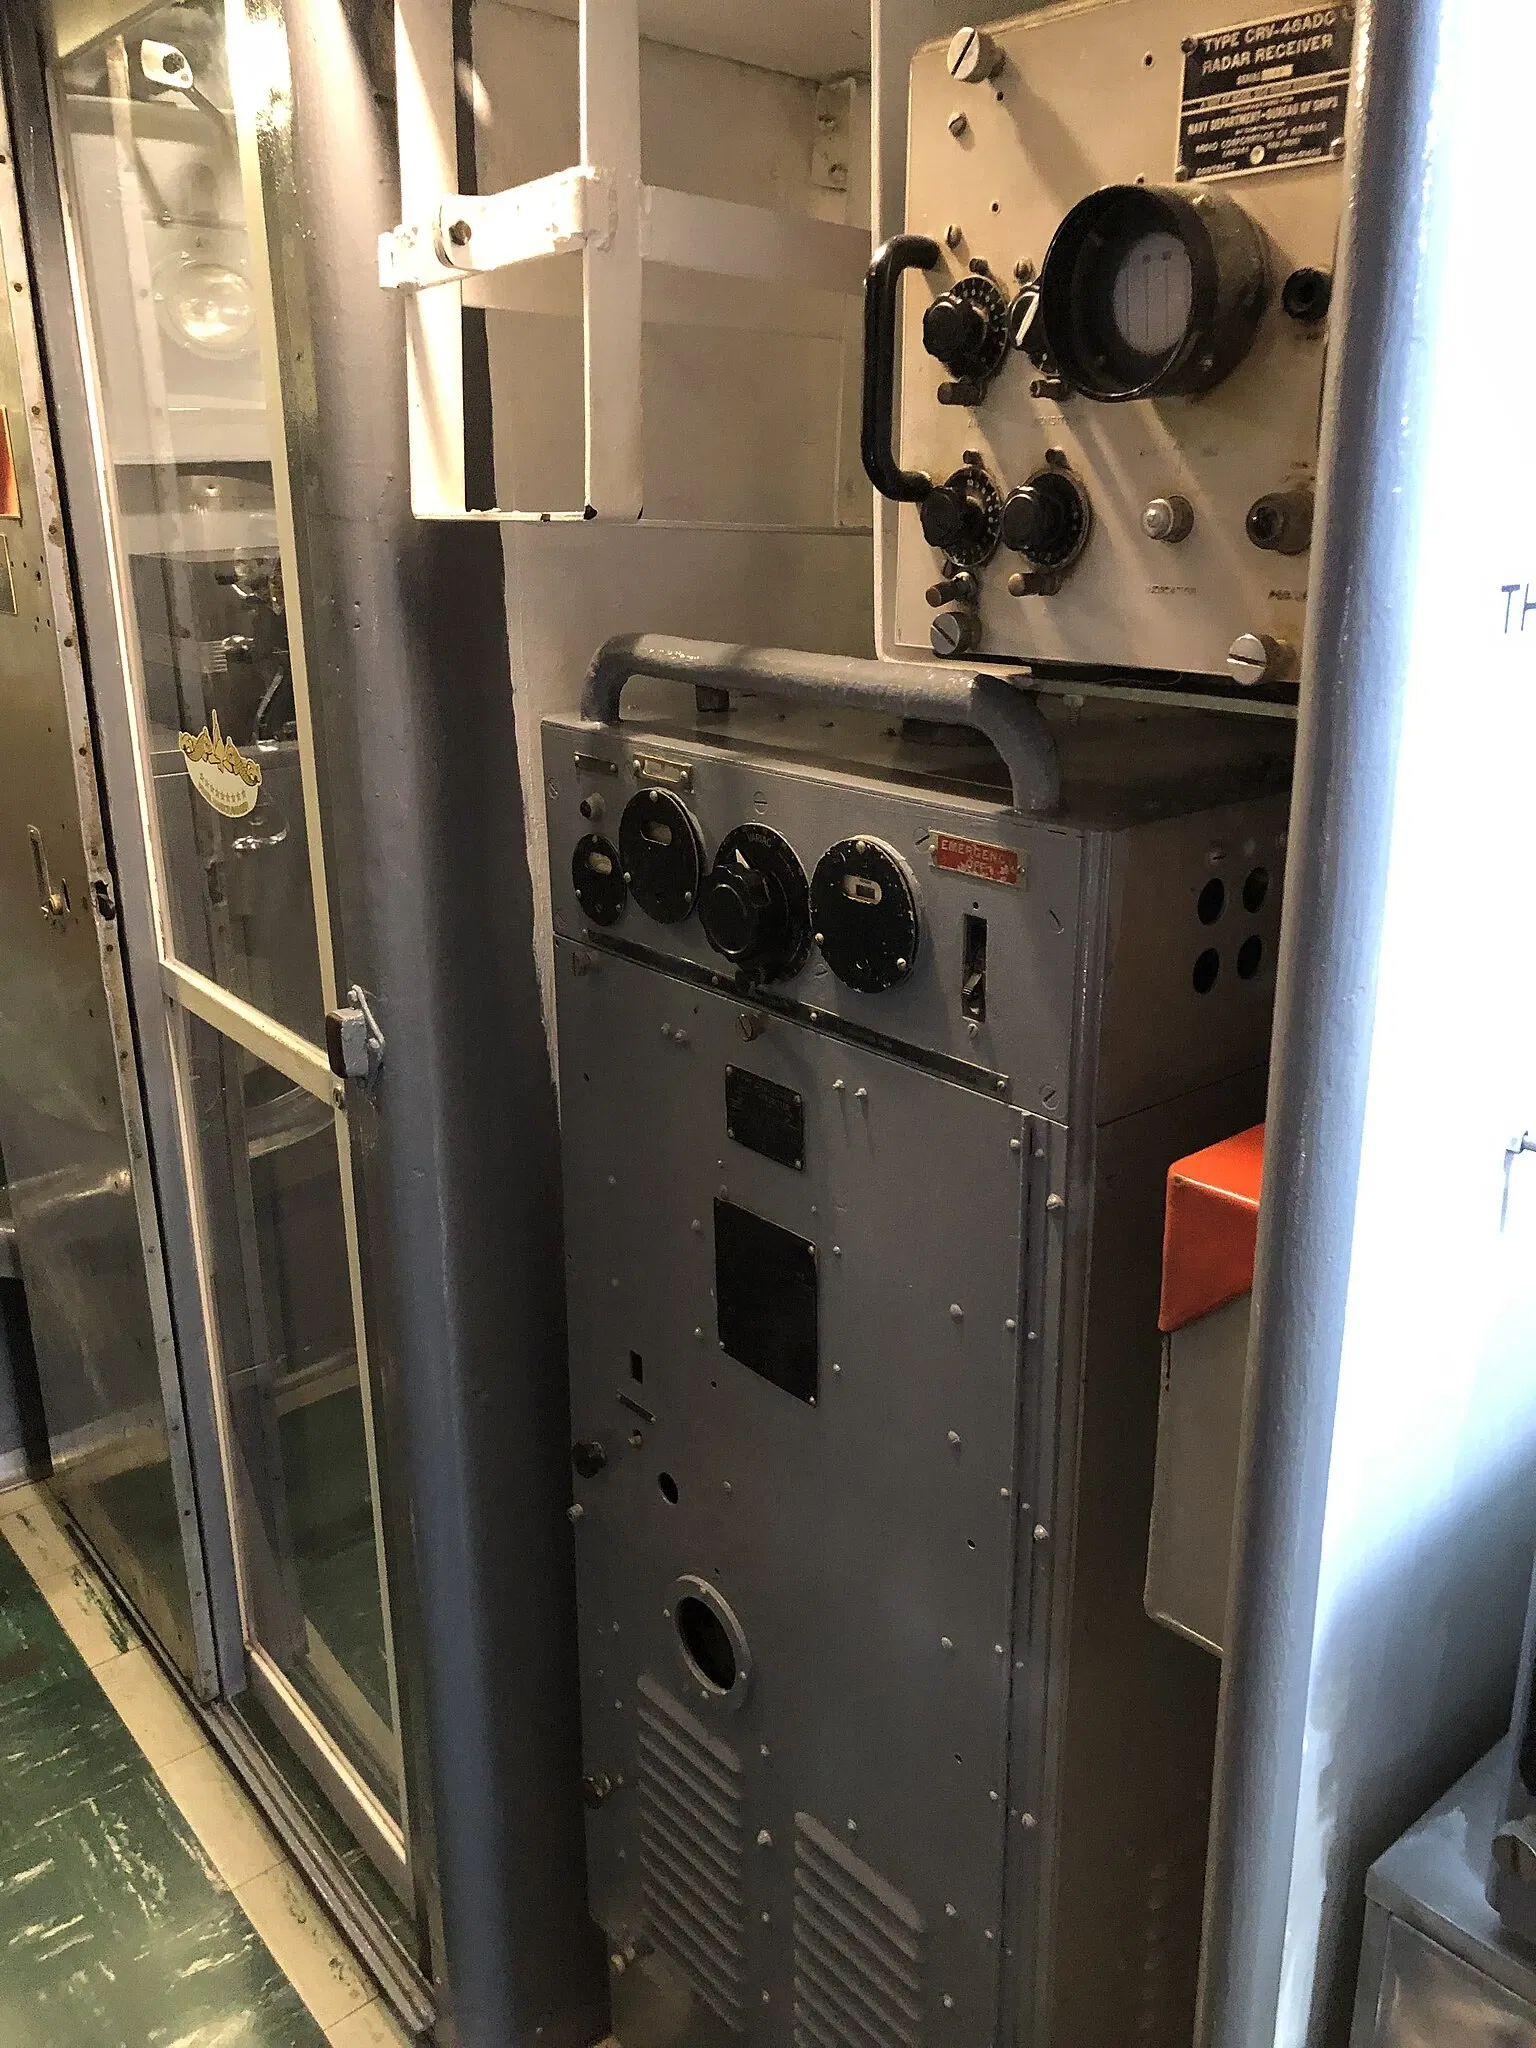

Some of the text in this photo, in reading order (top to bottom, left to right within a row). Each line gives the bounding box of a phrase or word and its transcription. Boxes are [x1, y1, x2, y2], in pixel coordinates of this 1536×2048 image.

[1204, 32, 1240, 52] TYPE
[1202, 34, 1334, 76] RADAR RECEIVER
[746, 832, 772, 848] VARIAC
